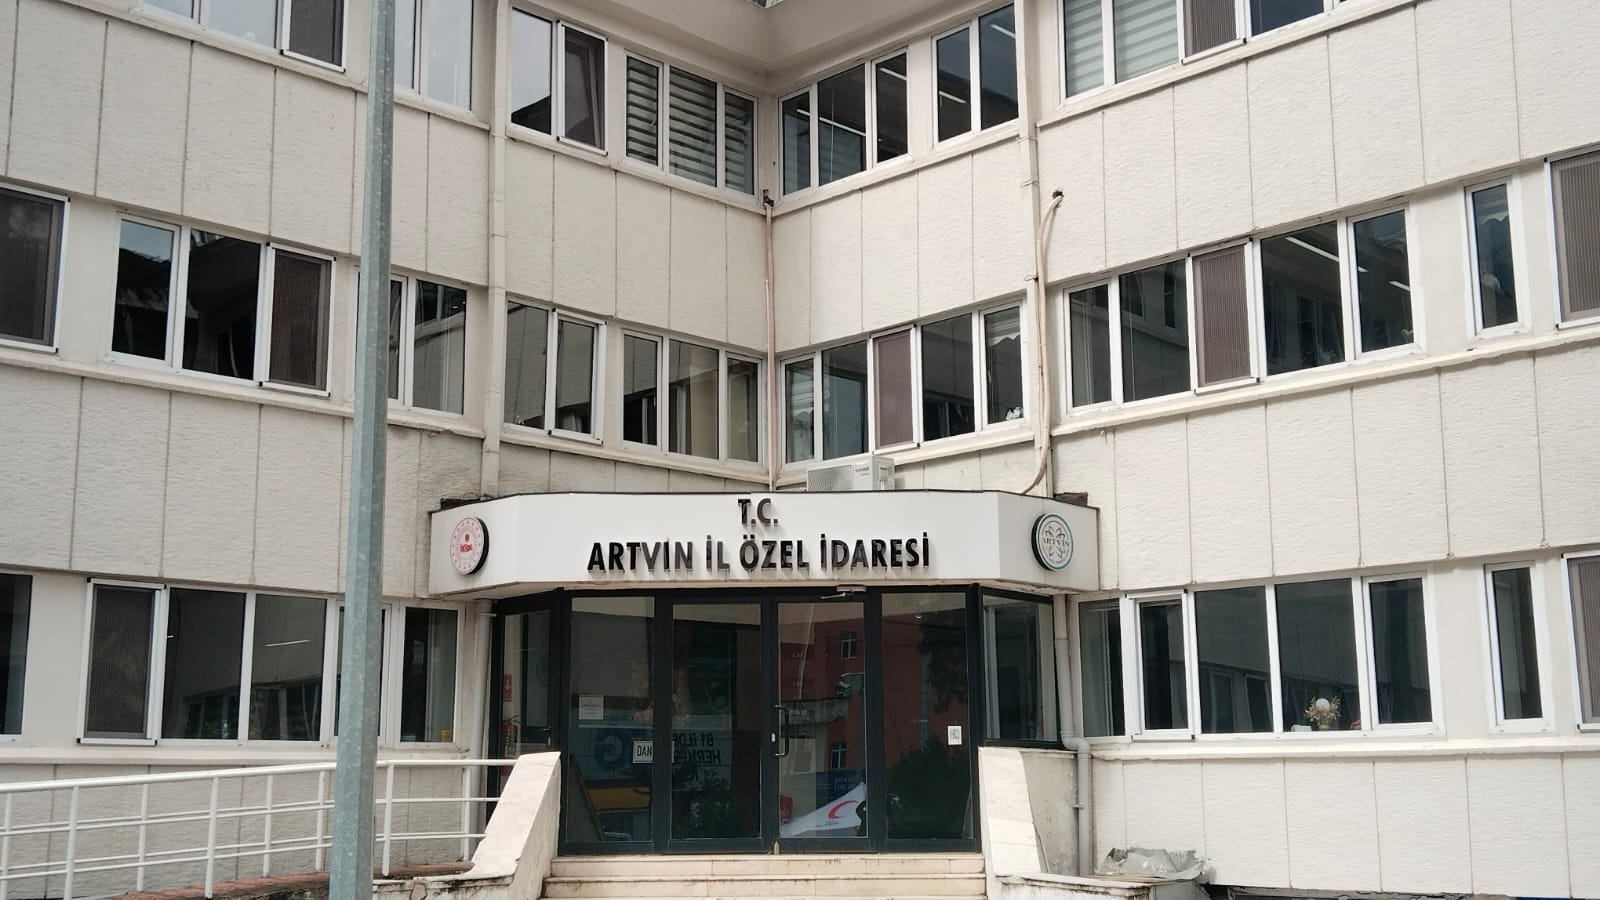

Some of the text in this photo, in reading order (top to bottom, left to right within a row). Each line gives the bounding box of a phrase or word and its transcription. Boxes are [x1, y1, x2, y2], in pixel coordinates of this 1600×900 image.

[738, 498, 778, 525] T.C.
[706, 534, 730, 571] İL
[739, 534, 810, 571] ÖZEL
[820, 532, 929, 569] İDARESİ
